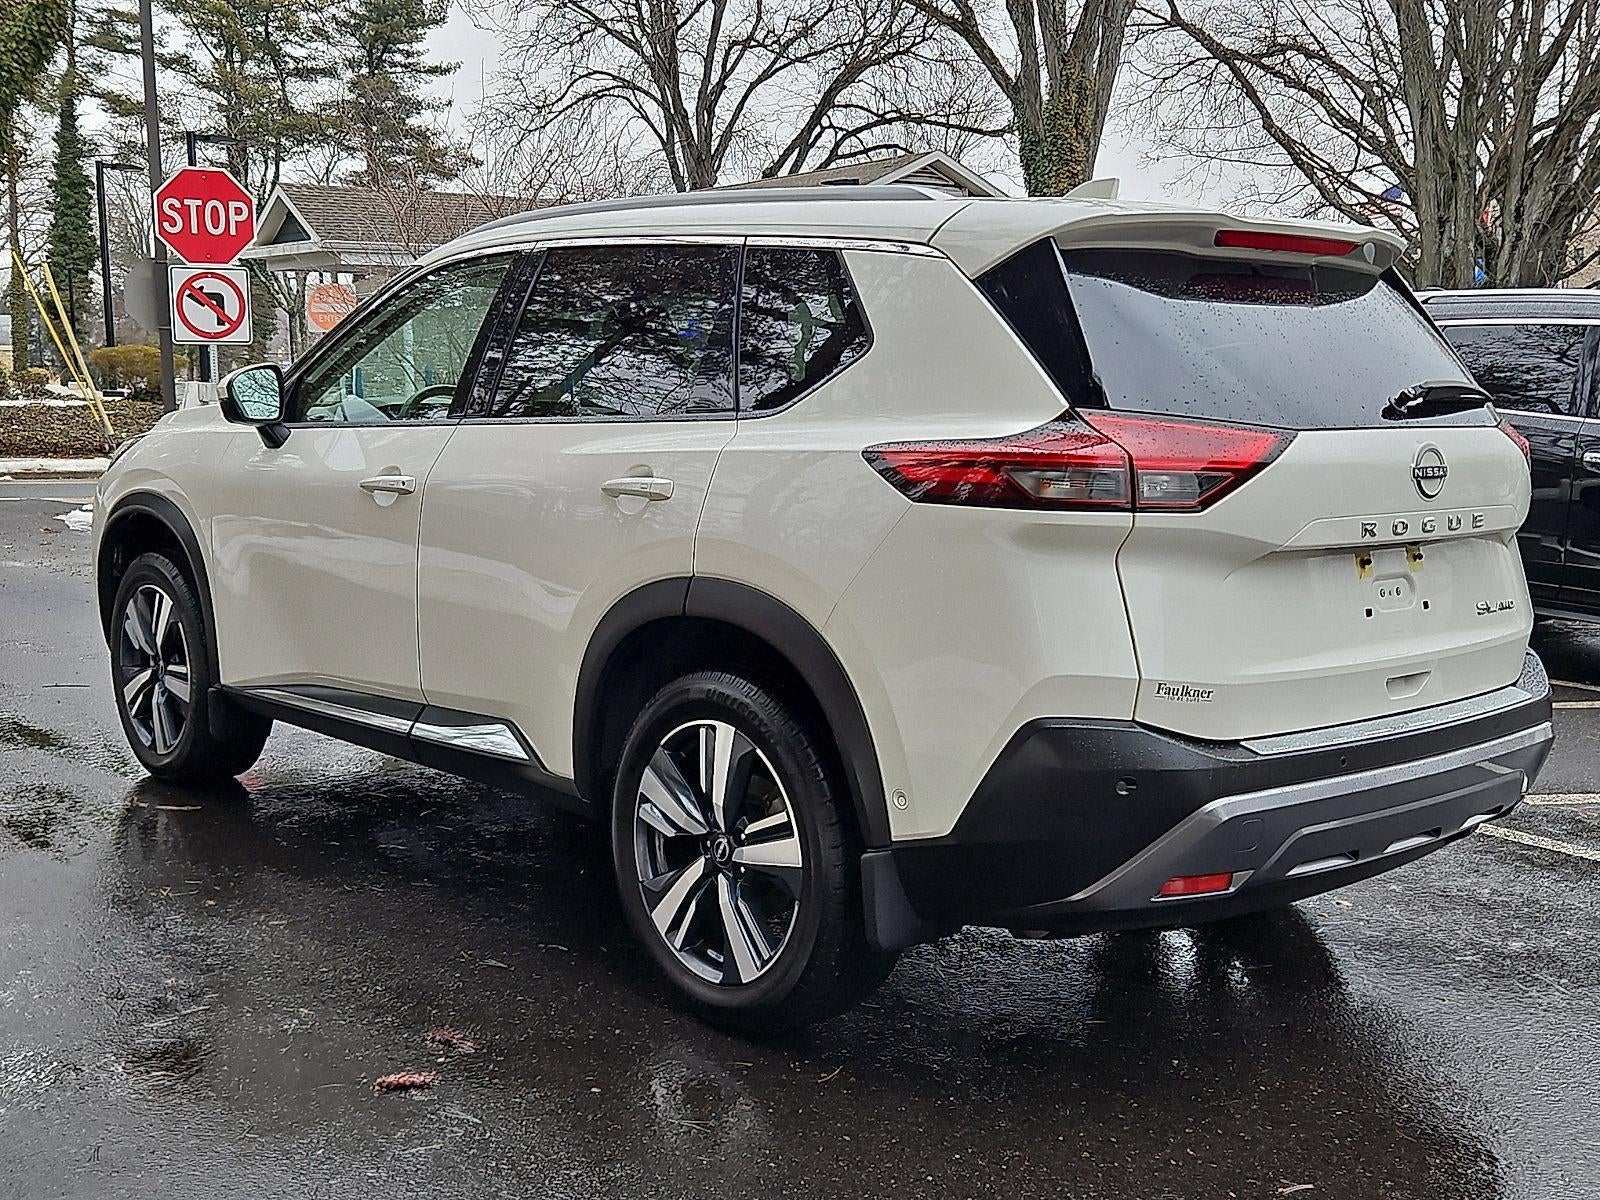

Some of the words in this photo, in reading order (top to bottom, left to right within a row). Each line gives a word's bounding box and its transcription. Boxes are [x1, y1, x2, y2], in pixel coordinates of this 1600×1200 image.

[162, 198, 249, 236] STOP
[319, 314, 344, 323] ENTE
[1361, 513, 1485, 538] ROGUE
[1155, 682, 1214, 699] Faulkner
